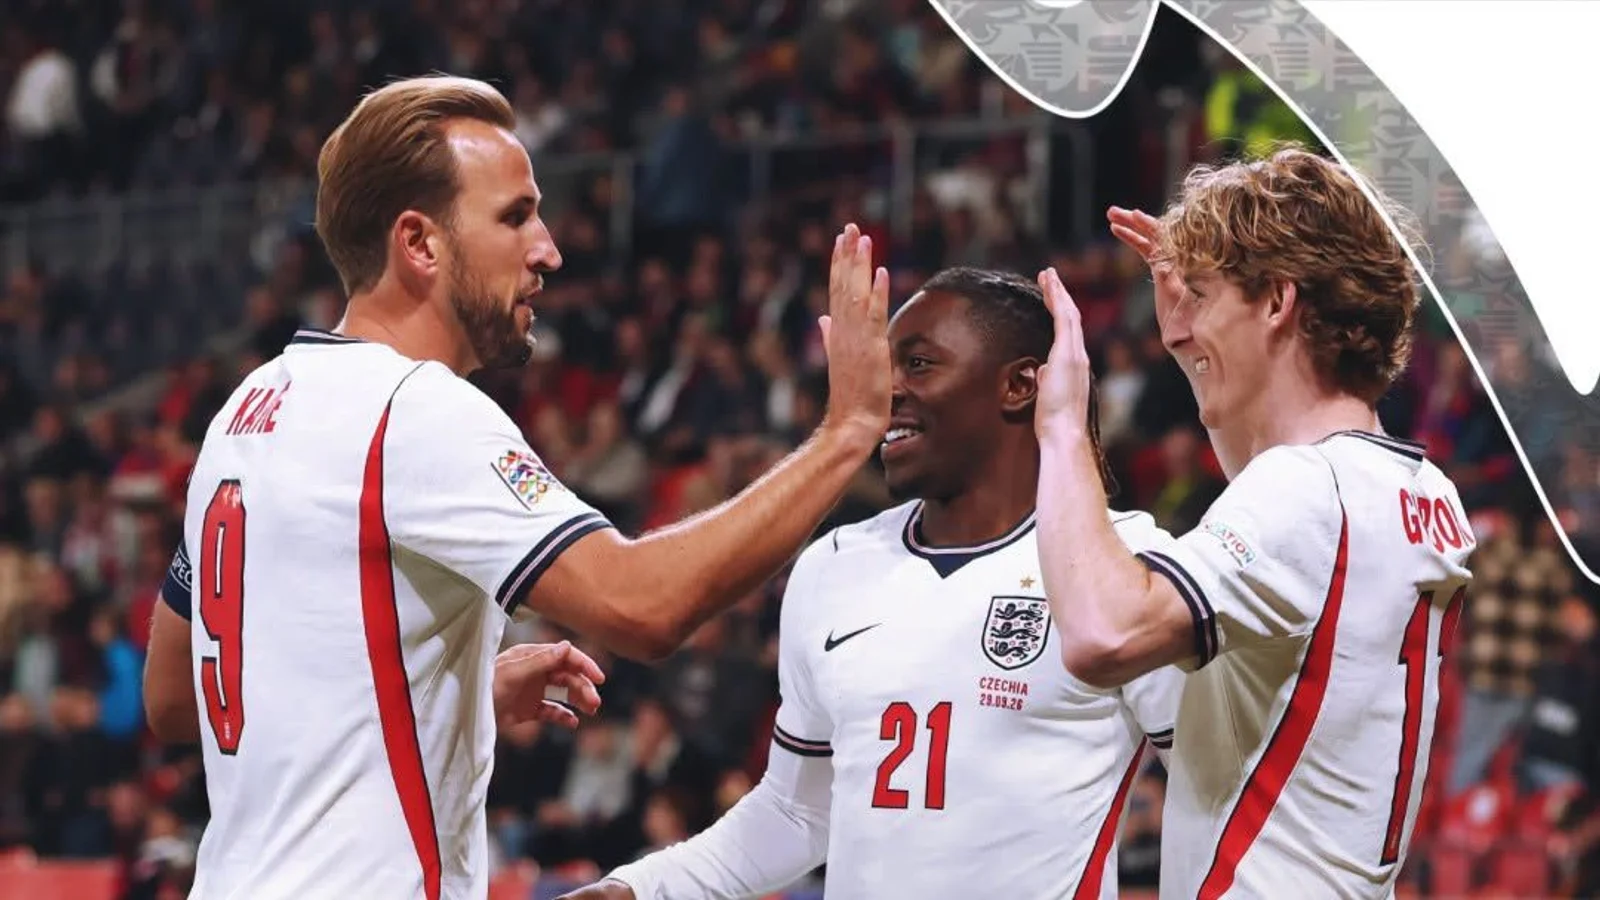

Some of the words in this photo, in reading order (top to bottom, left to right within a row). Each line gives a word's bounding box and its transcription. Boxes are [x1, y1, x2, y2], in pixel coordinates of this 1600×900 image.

[199, 479, 246, 755] 9
[979, 677, 1029, 696] CZECHIA
[871, 701, 952, 810] 21
